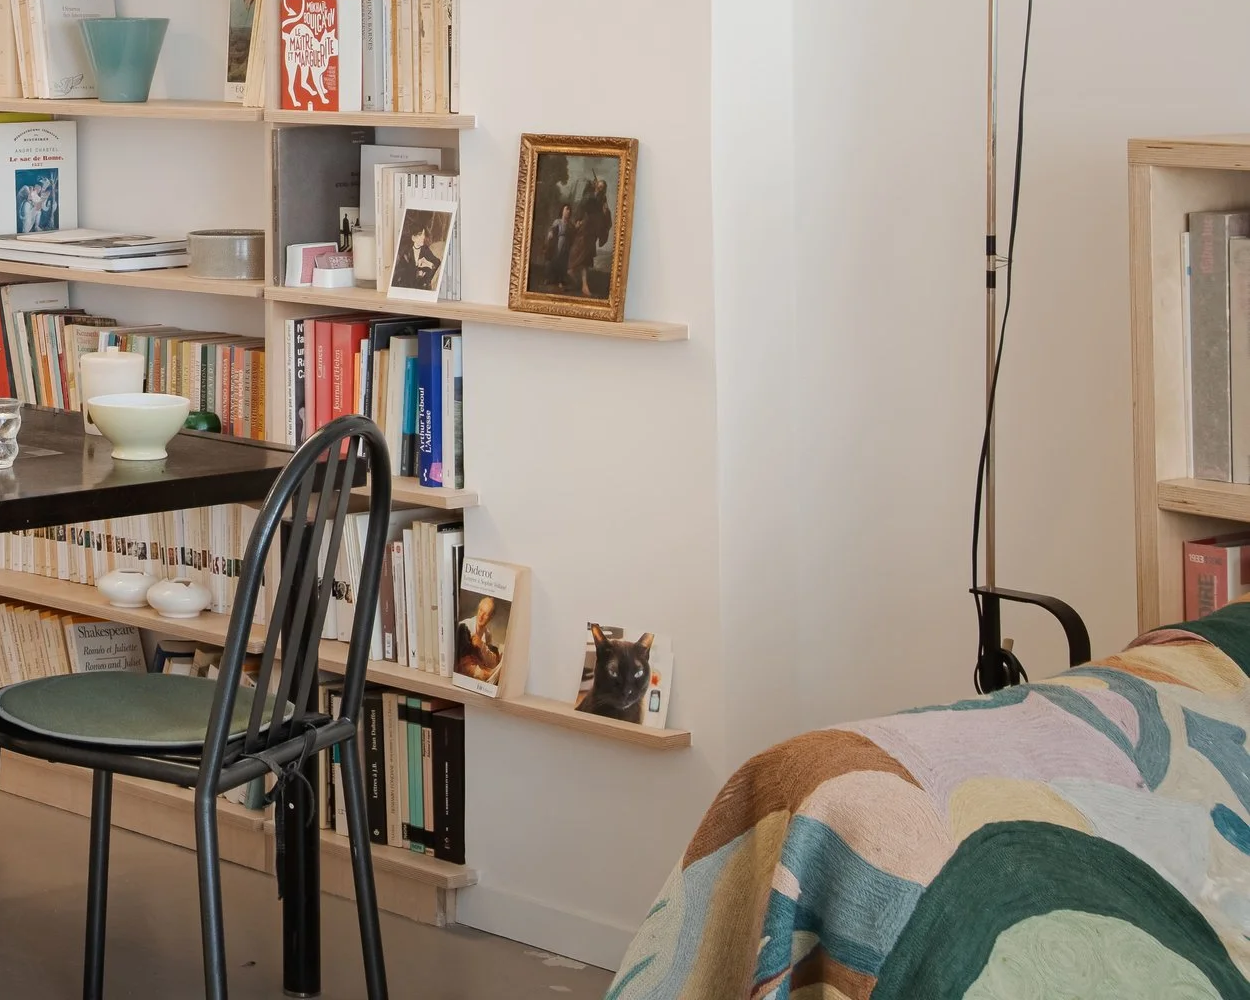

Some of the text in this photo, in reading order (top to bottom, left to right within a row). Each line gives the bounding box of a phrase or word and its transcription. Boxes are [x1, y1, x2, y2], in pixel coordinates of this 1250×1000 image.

[295, 28, 301, 37] LE
[288, 36, 335, 68] ET MARGUERITE
[315, 344, 323, 379] Carnets
[333, 382, 342, 412] Journal
[424, 409, 432, 453] L'Adresse
[464, 563, 493, 579] Diderot
[78, 625, 135, 639] Shakespeare
[83, 643, 138, 656] Roméo et Juliette
[85, 656, 142, 672] Romeo and Juliet
